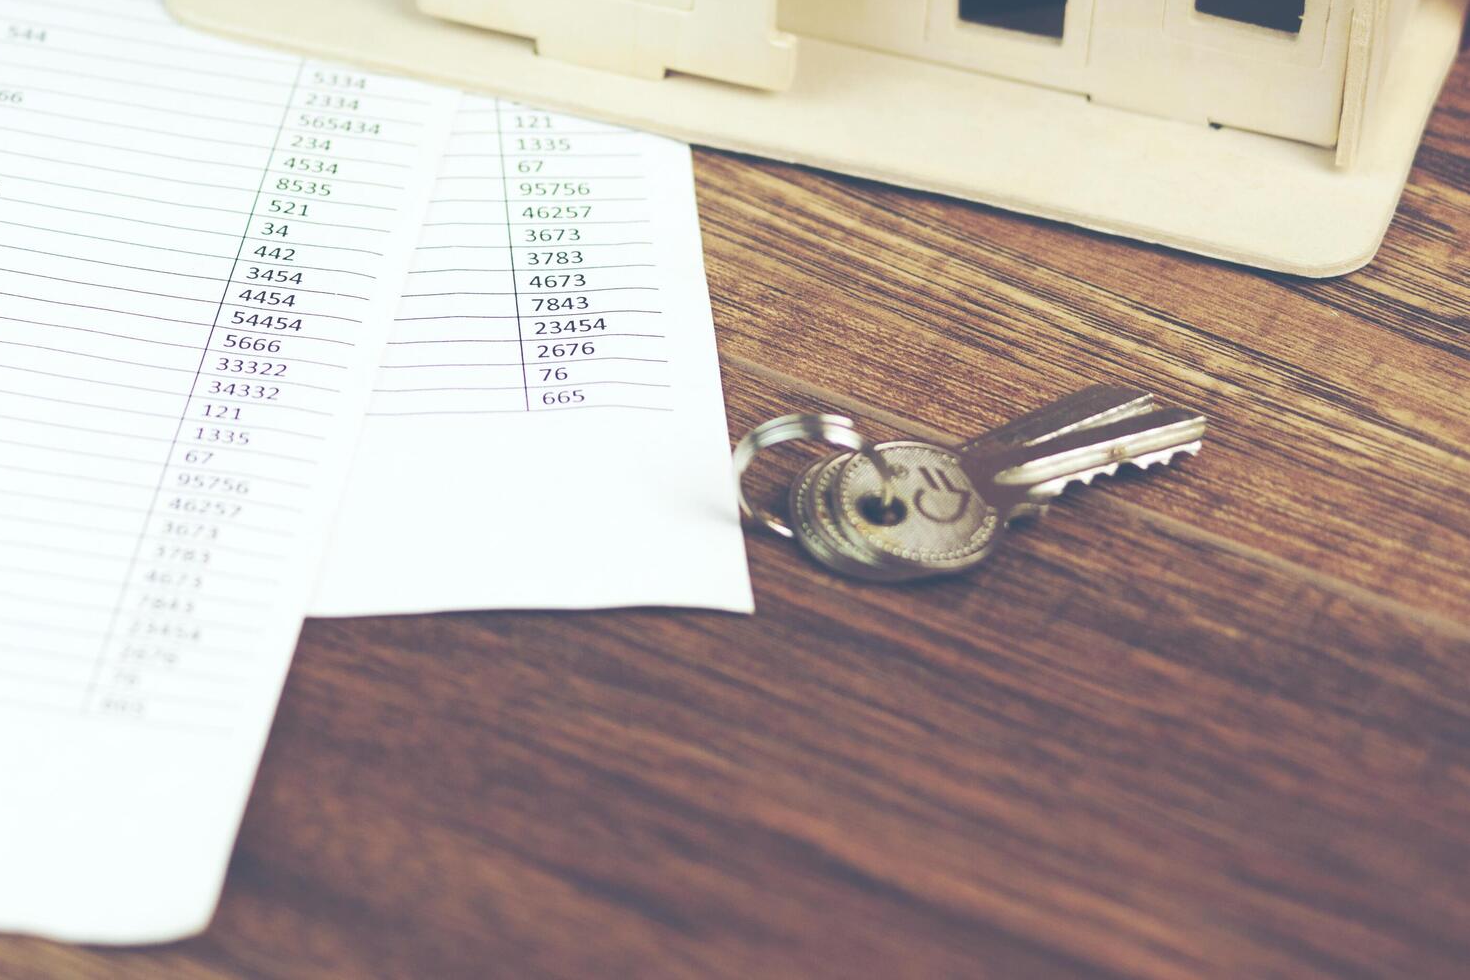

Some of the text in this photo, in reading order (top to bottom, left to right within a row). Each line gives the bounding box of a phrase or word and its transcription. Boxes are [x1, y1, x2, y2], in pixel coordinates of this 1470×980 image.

[314, 71, 366, 90] 5334
[305, 93, 360, 111] 2334
[298, 114, 381, 135] 565434
[515, 116, 553, 129] 121
[290, 135, 331, 152] 234
[516, 138, 571, 151] 1335
[283, 156, 339, 175] 4534
[518, 161, 544, 173] 67
[276, 178, 331, 197] 8535
[519, 183, 591, 196] 95756
[268, 199, 309, 217] 521
[522, 206, 593, 220] 46257
[260, 222, 289, 238] 34
[524, 228, 581, 242] 3673
[253, 245, 296, 262] 442
[526, 250, 584, 265] 3783
[246, 267, 303, 285] 3454
[529, 274, 587, 289] 4673
[238, 289, 296, 308] 4454
[531, 296, 590, 312] 7843
[231, 311, 303, 332] 54454
[534, 318, 608, 335] 23454
[223, 334, 282, 353] 5666
[538, 341, 595, 358] 2676
[216, 357, 287, 378] 33322
[539, 367, 568, 382] 76
[208, 380, 280, 401] 34332
[542, 389, 585, 405] 665
[202, 404, 242, 421] 121
[195, 427, 250, 446] 1335
[185, 450, 214, 465] 67
[177, 473, 250, 496] 95756
